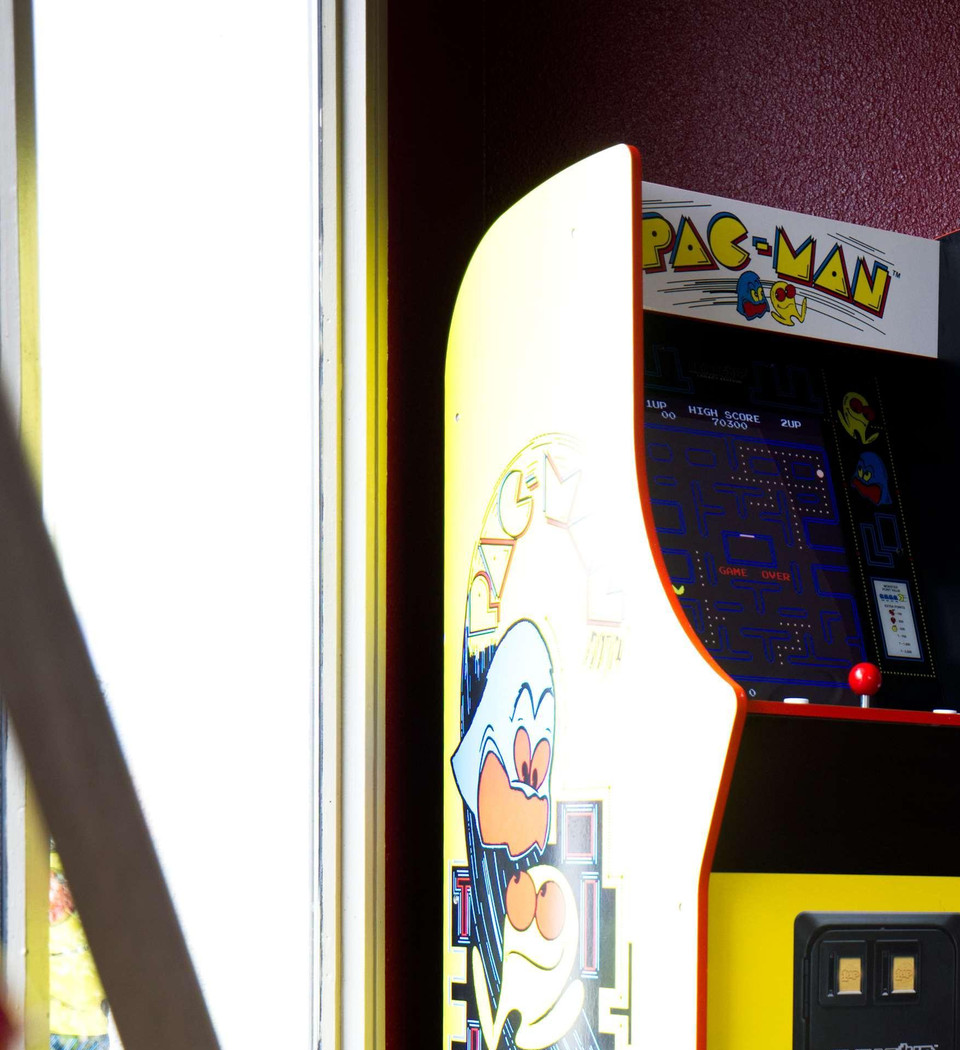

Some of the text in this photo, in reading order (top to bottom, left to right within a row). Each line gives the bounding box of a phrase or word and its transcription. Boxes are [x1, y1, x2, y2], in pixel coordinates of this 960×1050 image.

[642, 212, 892, 318] PAC-MAN
[646, 399, 802, 429] 1UP HIGH SCORE 2UP
[711, 417, 748, 430] 70300
[719, 566, 791, 581] GAME OVER
